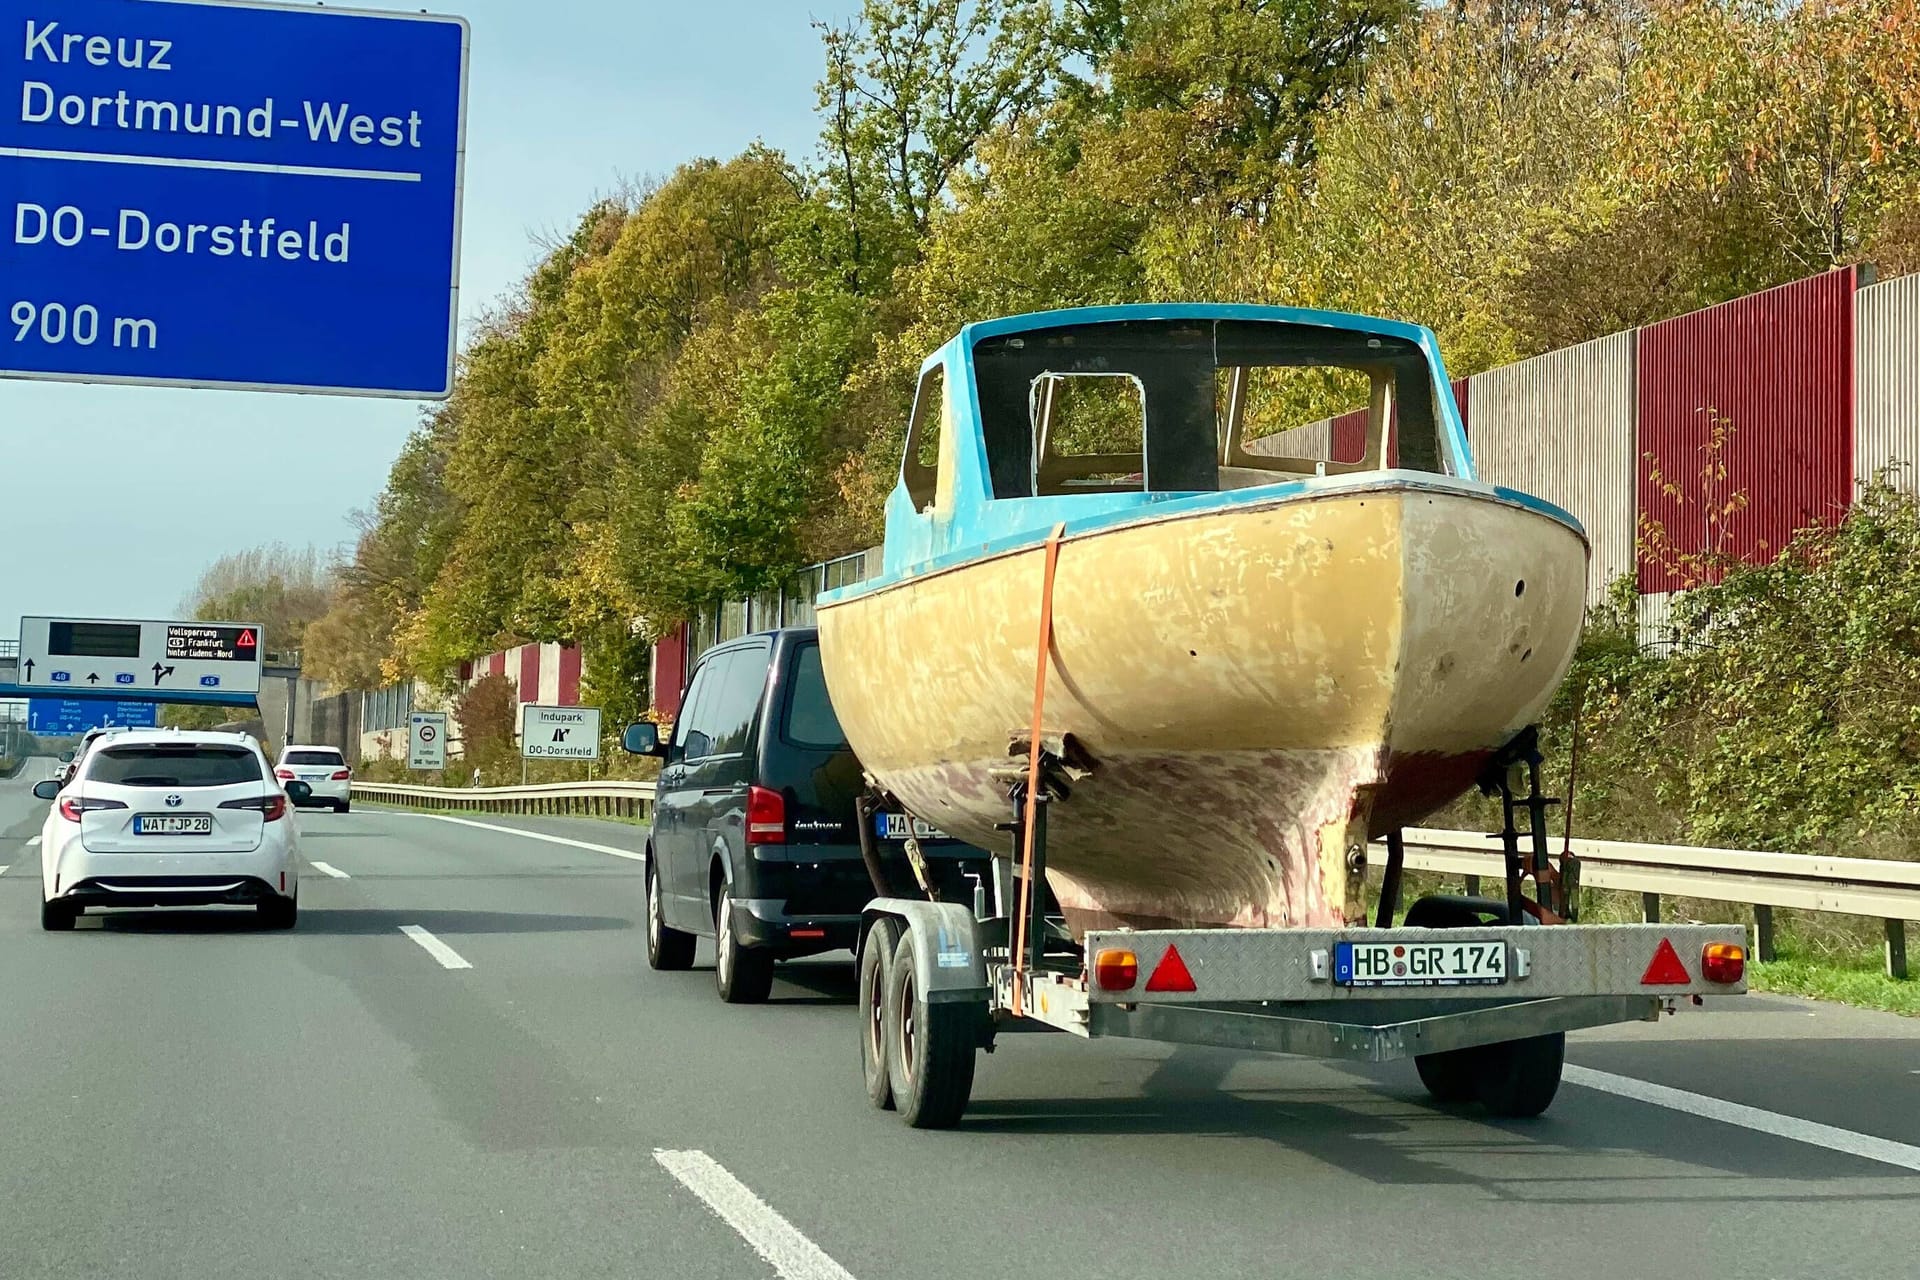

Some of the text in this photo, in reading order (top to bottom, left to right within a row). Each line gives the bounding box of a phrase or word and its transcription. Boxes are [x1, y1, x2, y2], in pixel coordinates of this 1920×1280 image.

[24, 20, 173, 71] Kreuz
[21, 81, 422, 148] Dortmund-West
[15, 203, 350, 263] DO-Dorstfeld
[10, 301, 157, 349] 900 m
[168, 627, 217, 638] Vollsperrung
[188, 638, 223, 648] Frankfurt
[167, 649, 187, 657] hinter
[55, 673, 65, 681] 40
[120, 675, 130, 683] 40
[541, 712, 583, 724] Indupark
[529, 745, 592, 756] DO-Dorstfeld
[143, 818, 209, 831] WAT JP 28
[1354, 946, 1502, 976] HB GR 174
